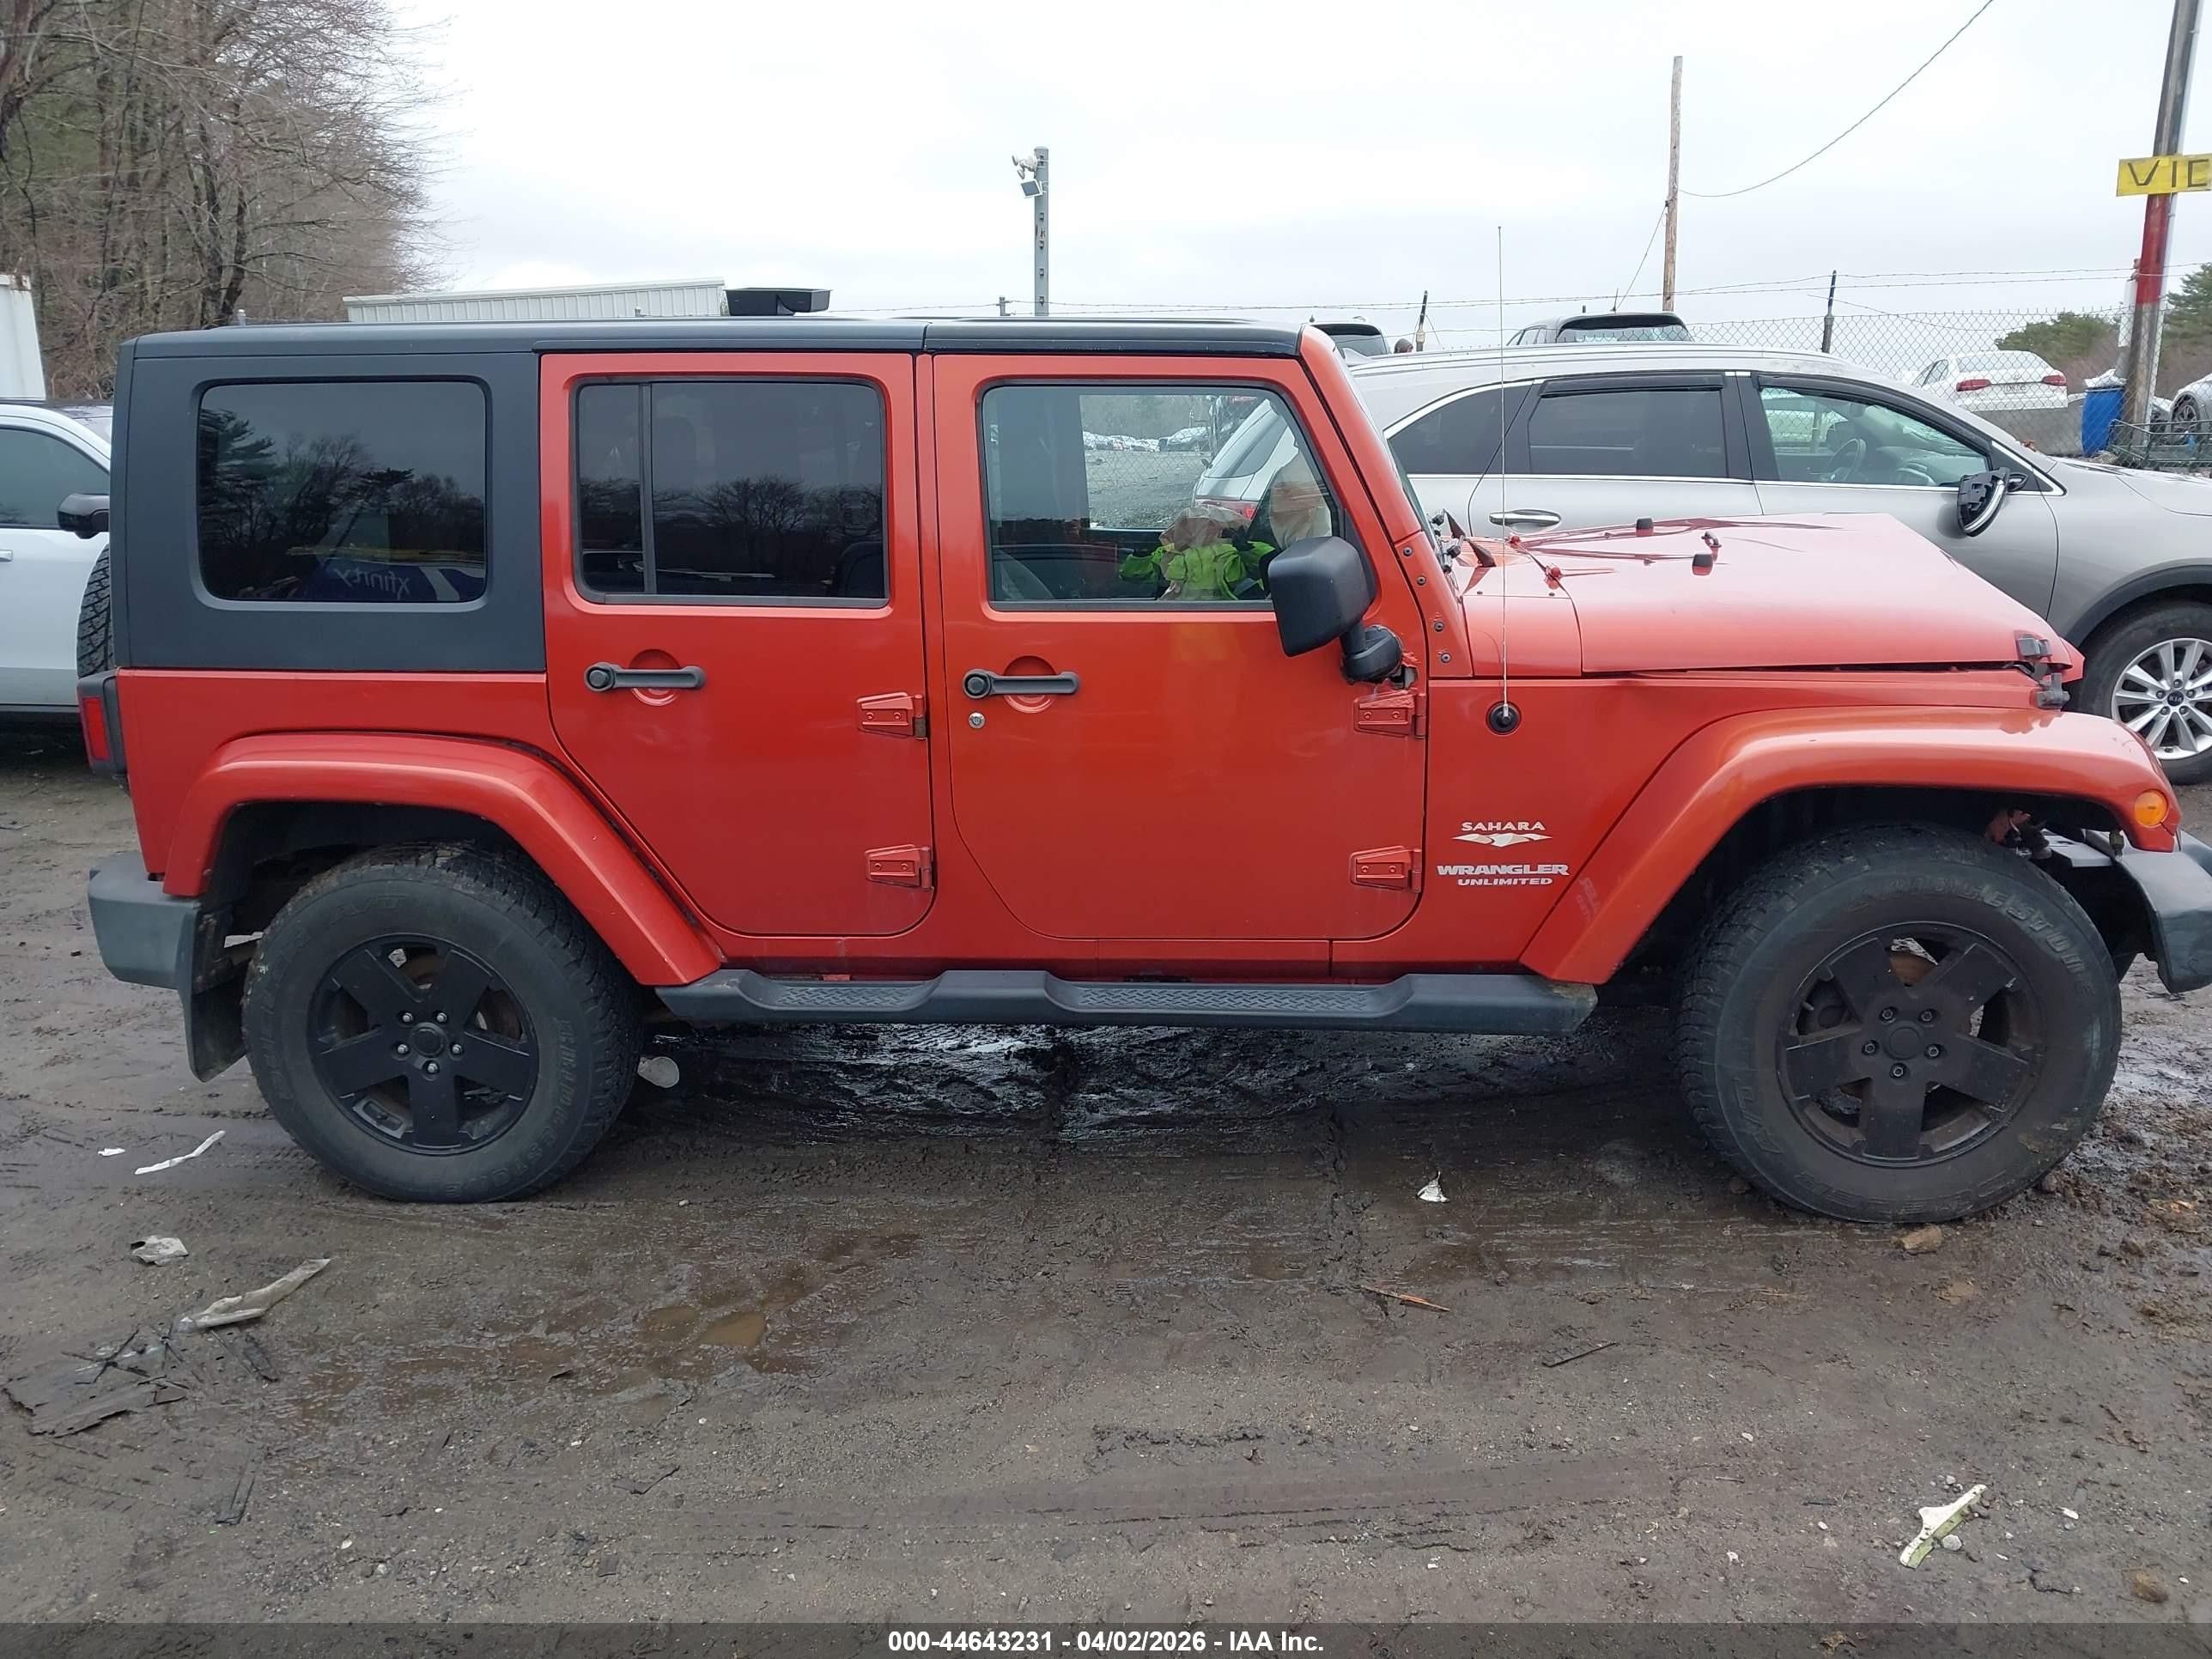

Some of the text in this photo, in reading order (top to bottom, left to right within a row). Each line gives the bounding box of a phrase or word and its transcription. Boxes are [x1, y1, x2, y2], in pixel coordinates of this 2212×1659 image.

[1462, 822, 1546, 831] SAHARA
[1437, 864, 1570, 876] WRANGLER
[1457, 878, 1553, 886] UNLIMITED
